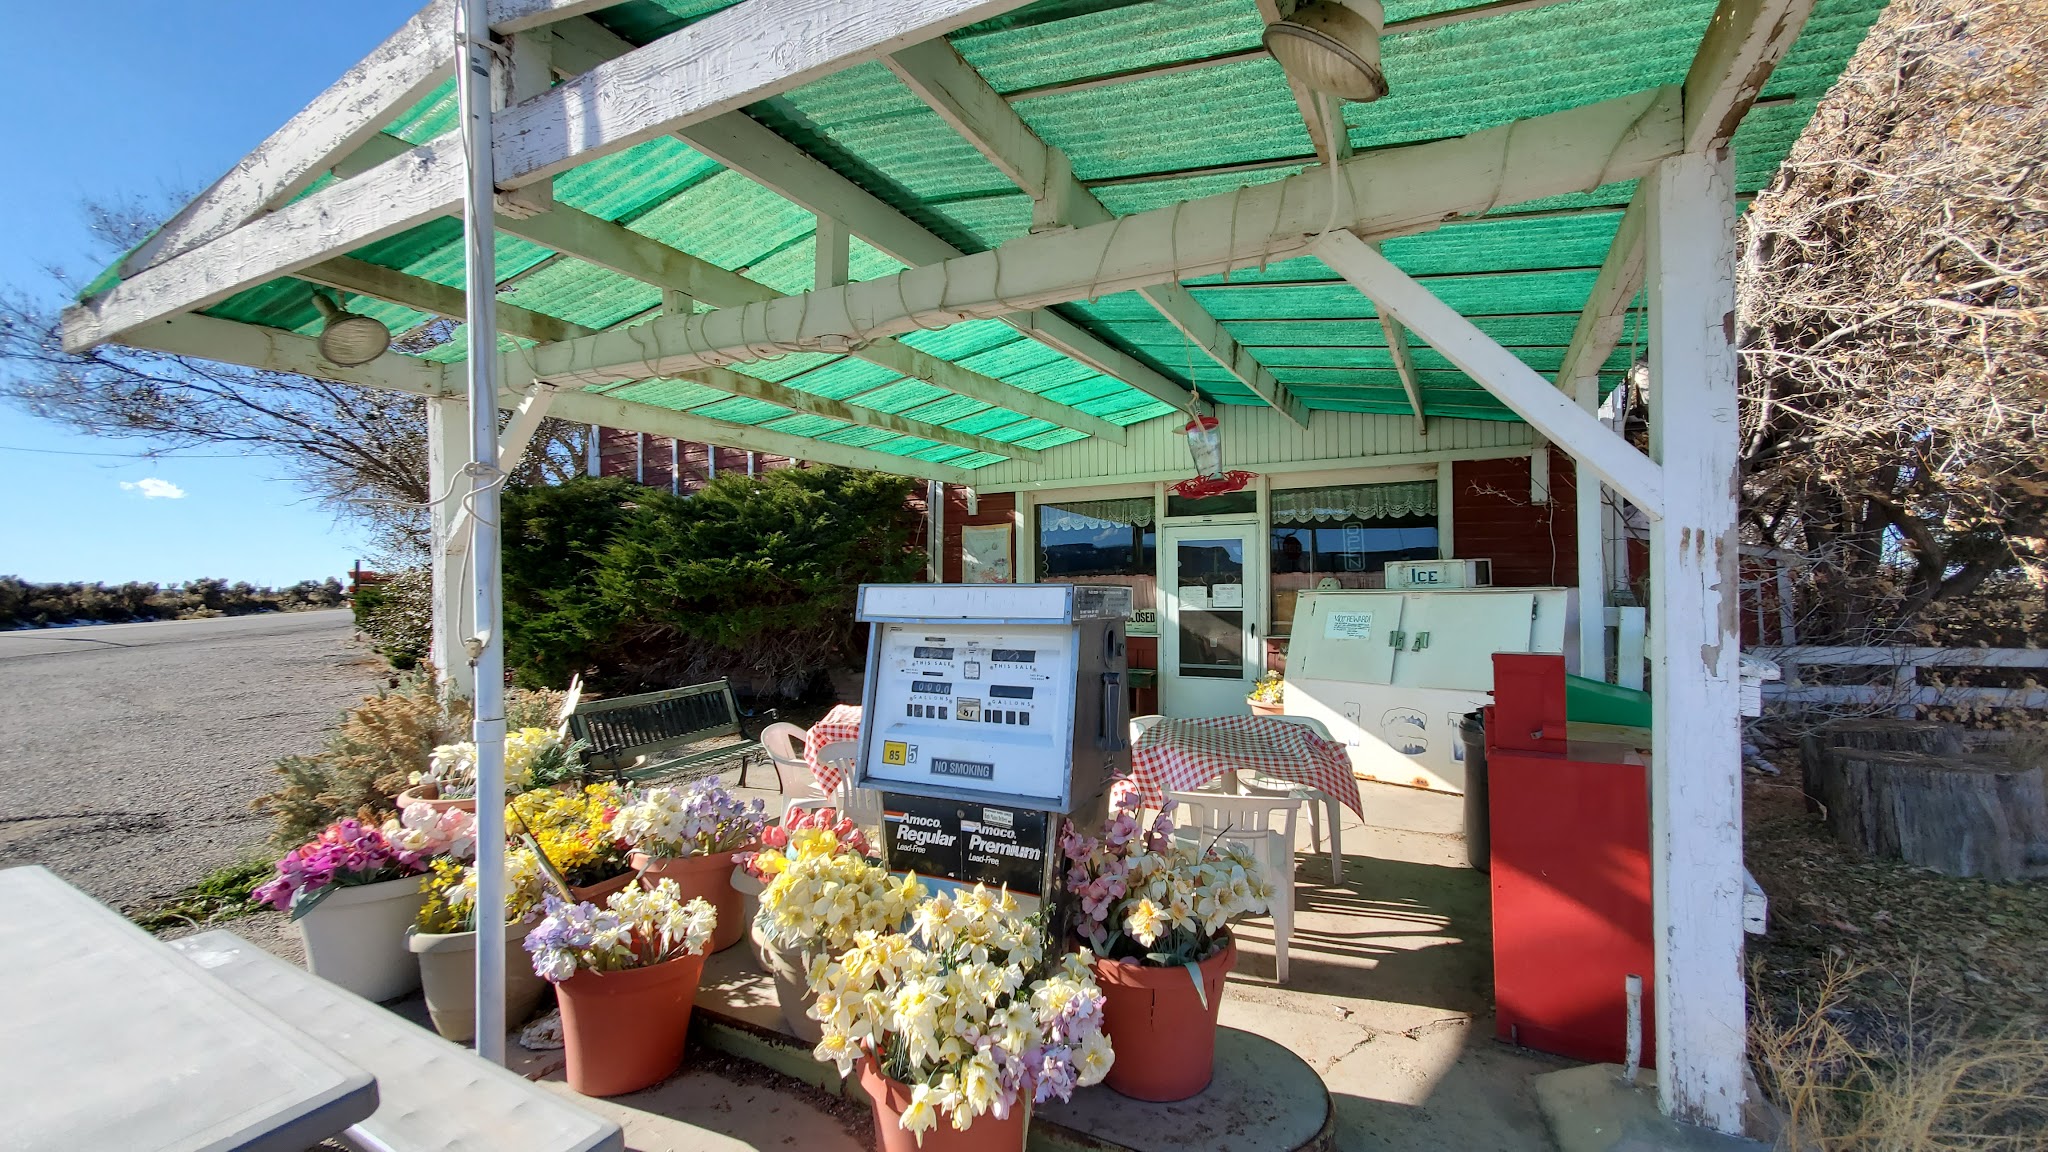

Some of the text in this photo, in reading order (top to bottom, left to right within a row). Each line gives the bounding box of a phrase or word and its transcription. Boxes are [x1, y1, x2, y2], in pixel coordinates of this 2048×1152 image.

[1411, 568, 1438, 583] ICE
[992, 699, 1031, 707] GALLONS
[889, 750, 900, 760] 85
[908, 745, 918, 763] 5
[935, 761, 990, 777] NO SMOKING
[896, 825, 957, 847] Regular
[896, 843, 927, 854] Lead-Free
[968, 834, 1041, 861] Premium
[968, 853, 1000, 867] Lead-Free
